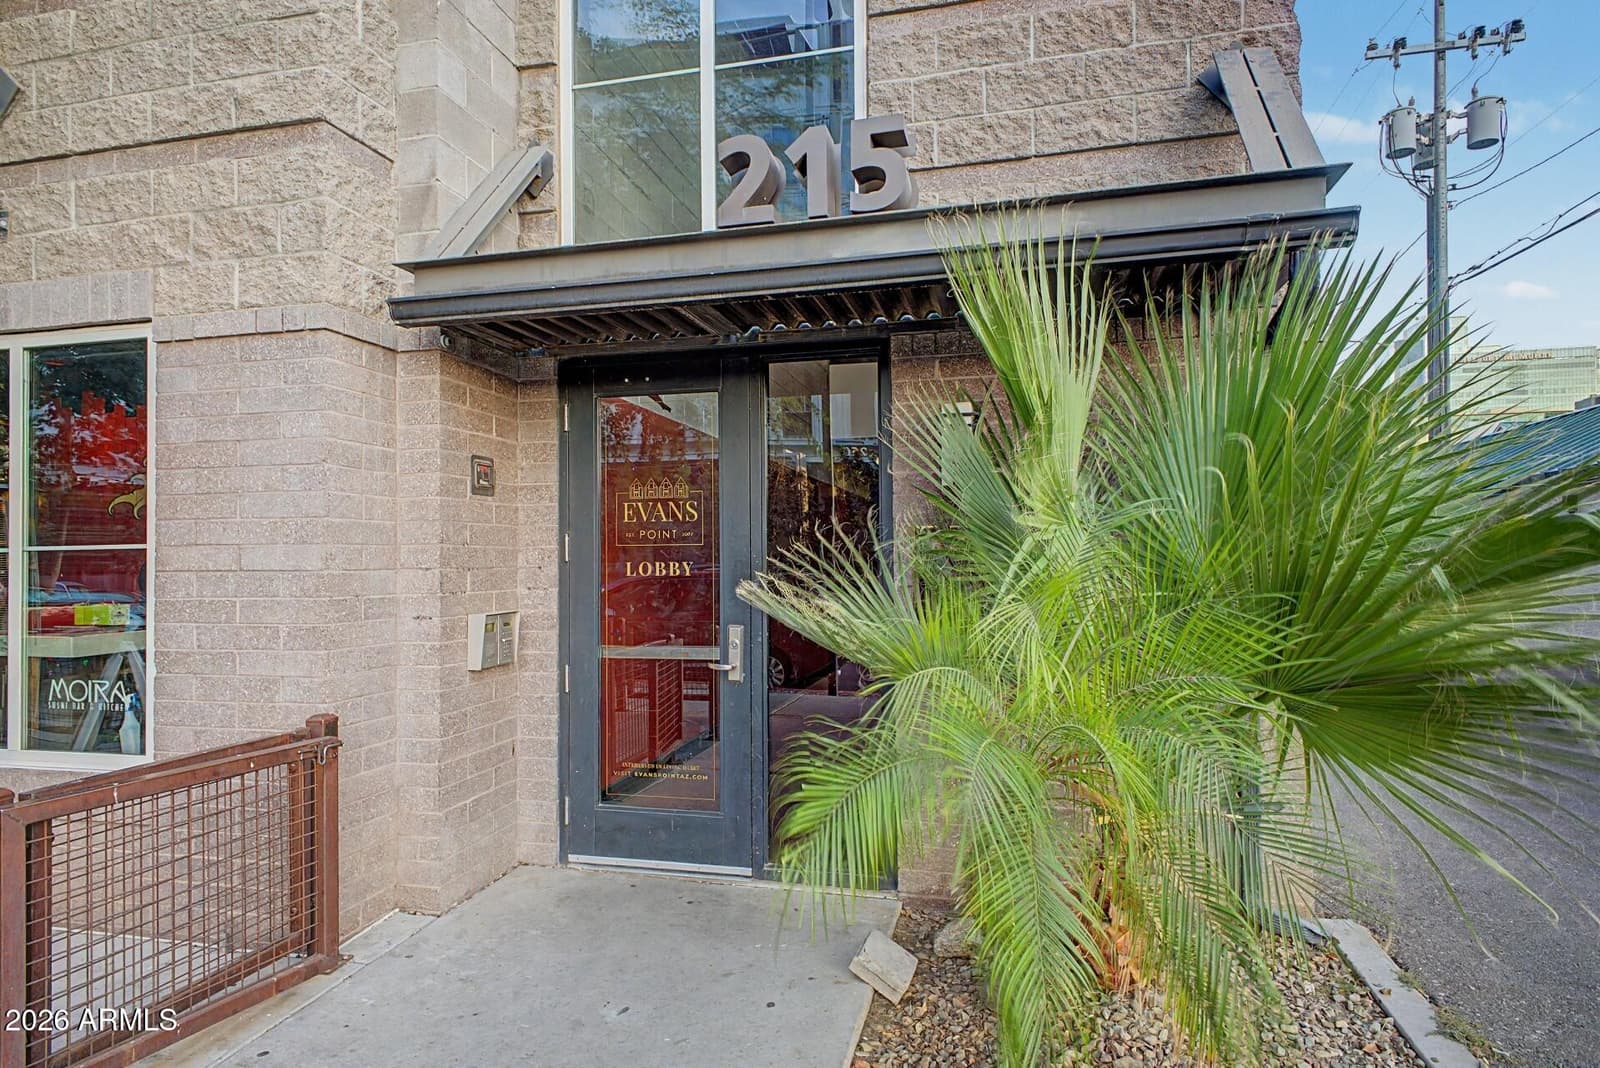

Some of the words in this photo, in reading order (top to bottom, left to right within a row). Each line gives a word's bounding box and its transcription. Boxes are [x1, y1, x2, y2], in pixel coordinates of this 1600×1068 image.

[718, 114, 916, 228] 215
[623, 500, 698, 523] EVANS
[639, 529, 677, 540] POINT
[625, 561, 693, 577] LOBBY
[48, 678, 127, 703] MOIRA
[634, 771, 708, 780] EVANSPOINTAZ.COM
